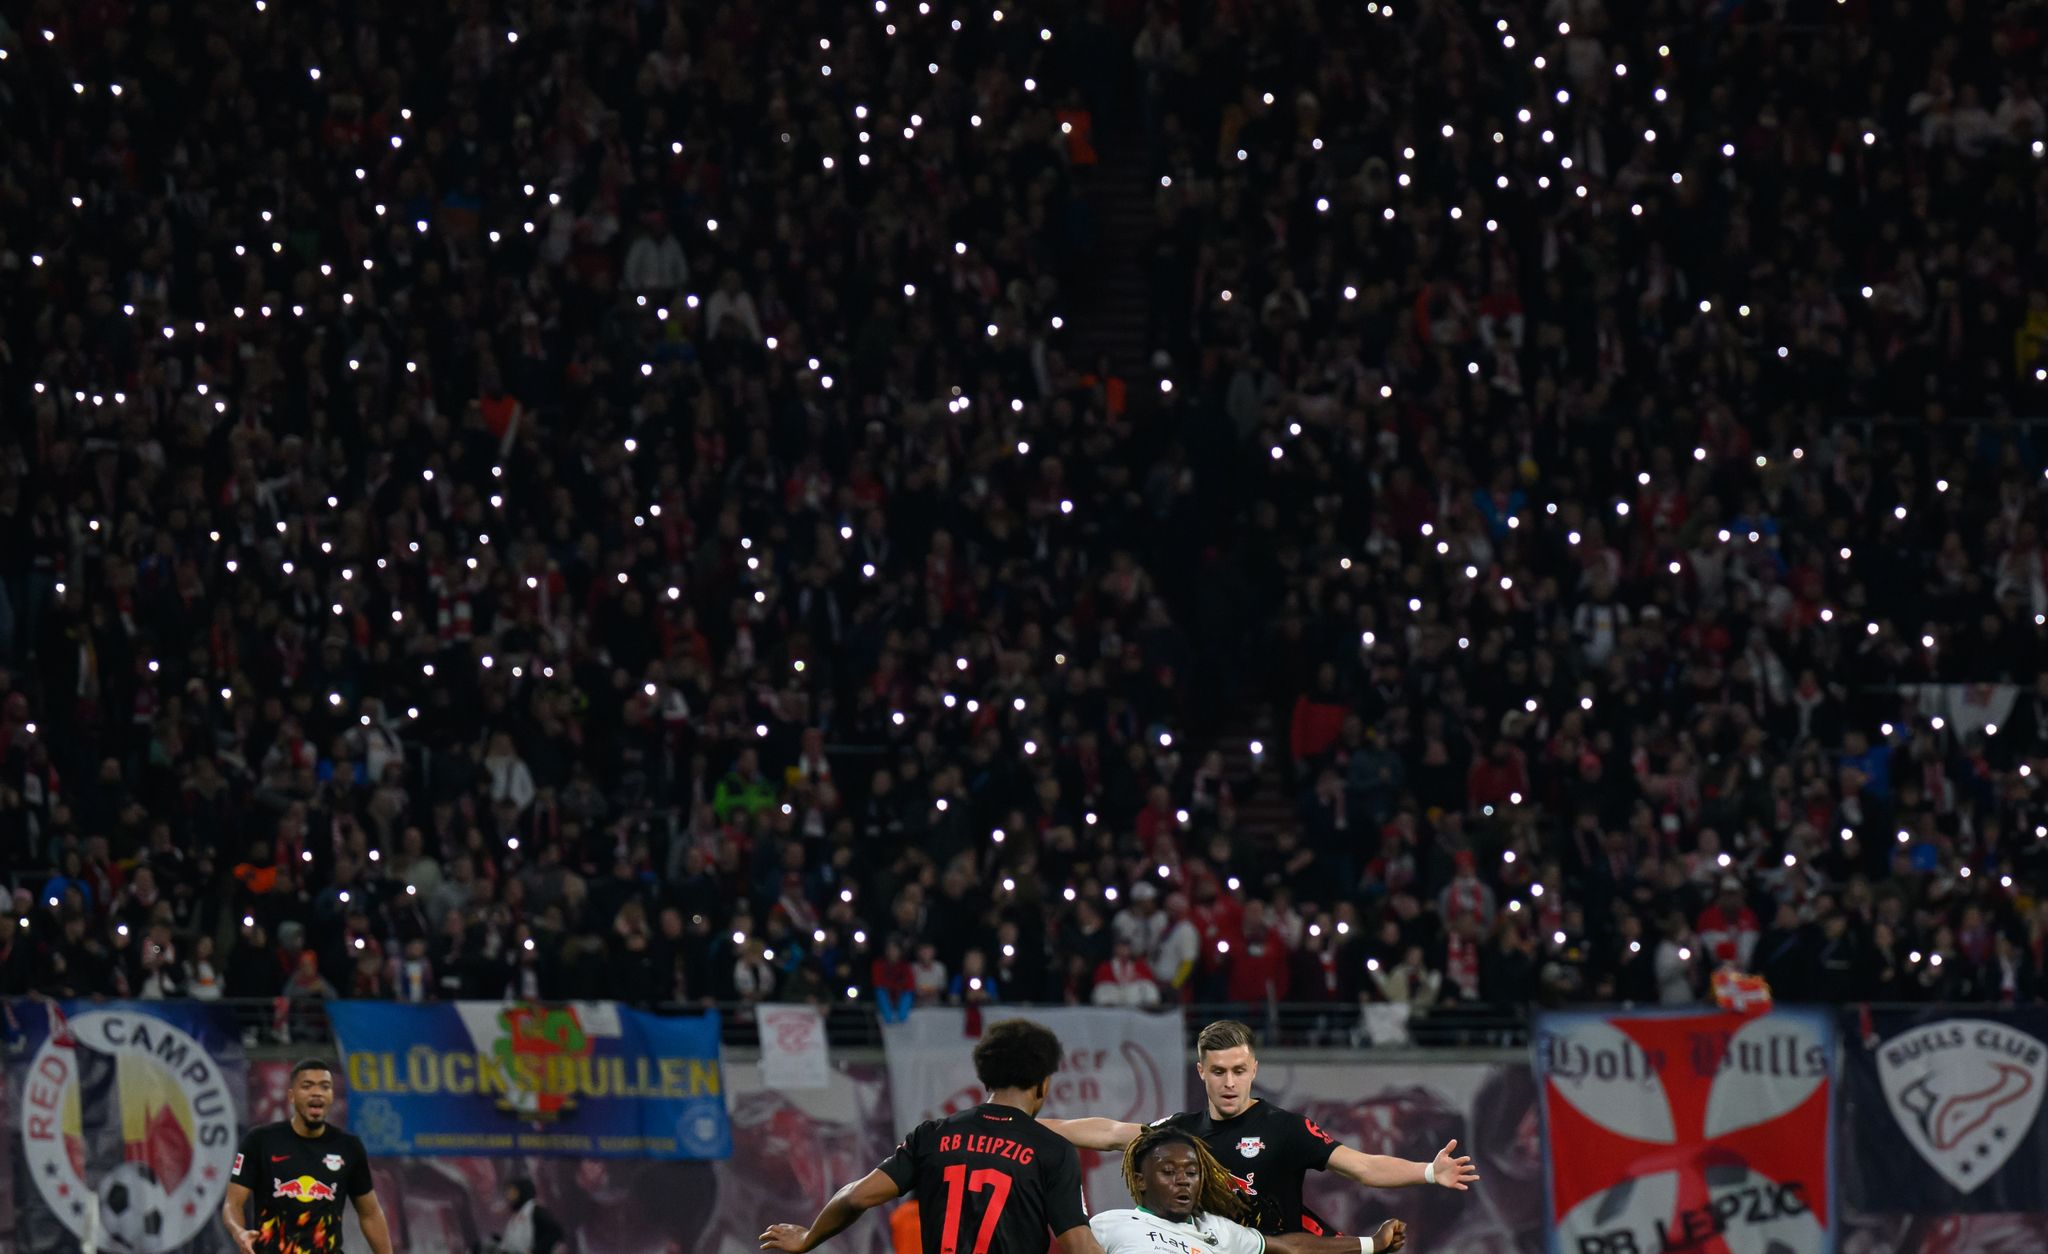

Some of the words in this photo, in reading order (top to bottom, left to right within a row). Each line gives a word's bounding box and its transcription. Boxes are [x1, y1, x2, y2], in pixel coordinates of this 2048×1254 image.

[348, 1045, 721, 1097] GLÜCKSBULLEN
[1887, 1027, 1965, 1068] BULLS
[1974, 1029, 2041, 1066] CLUB
[28, 1055, 69, 1142] RED
[103, 1017, 230, 1147] CAMPUS
[940, 1134, 962, 1153] RB
[966, 1134, 1035, 1166] LEIPZIG
[941, 1163, 1013, 1254] 17
